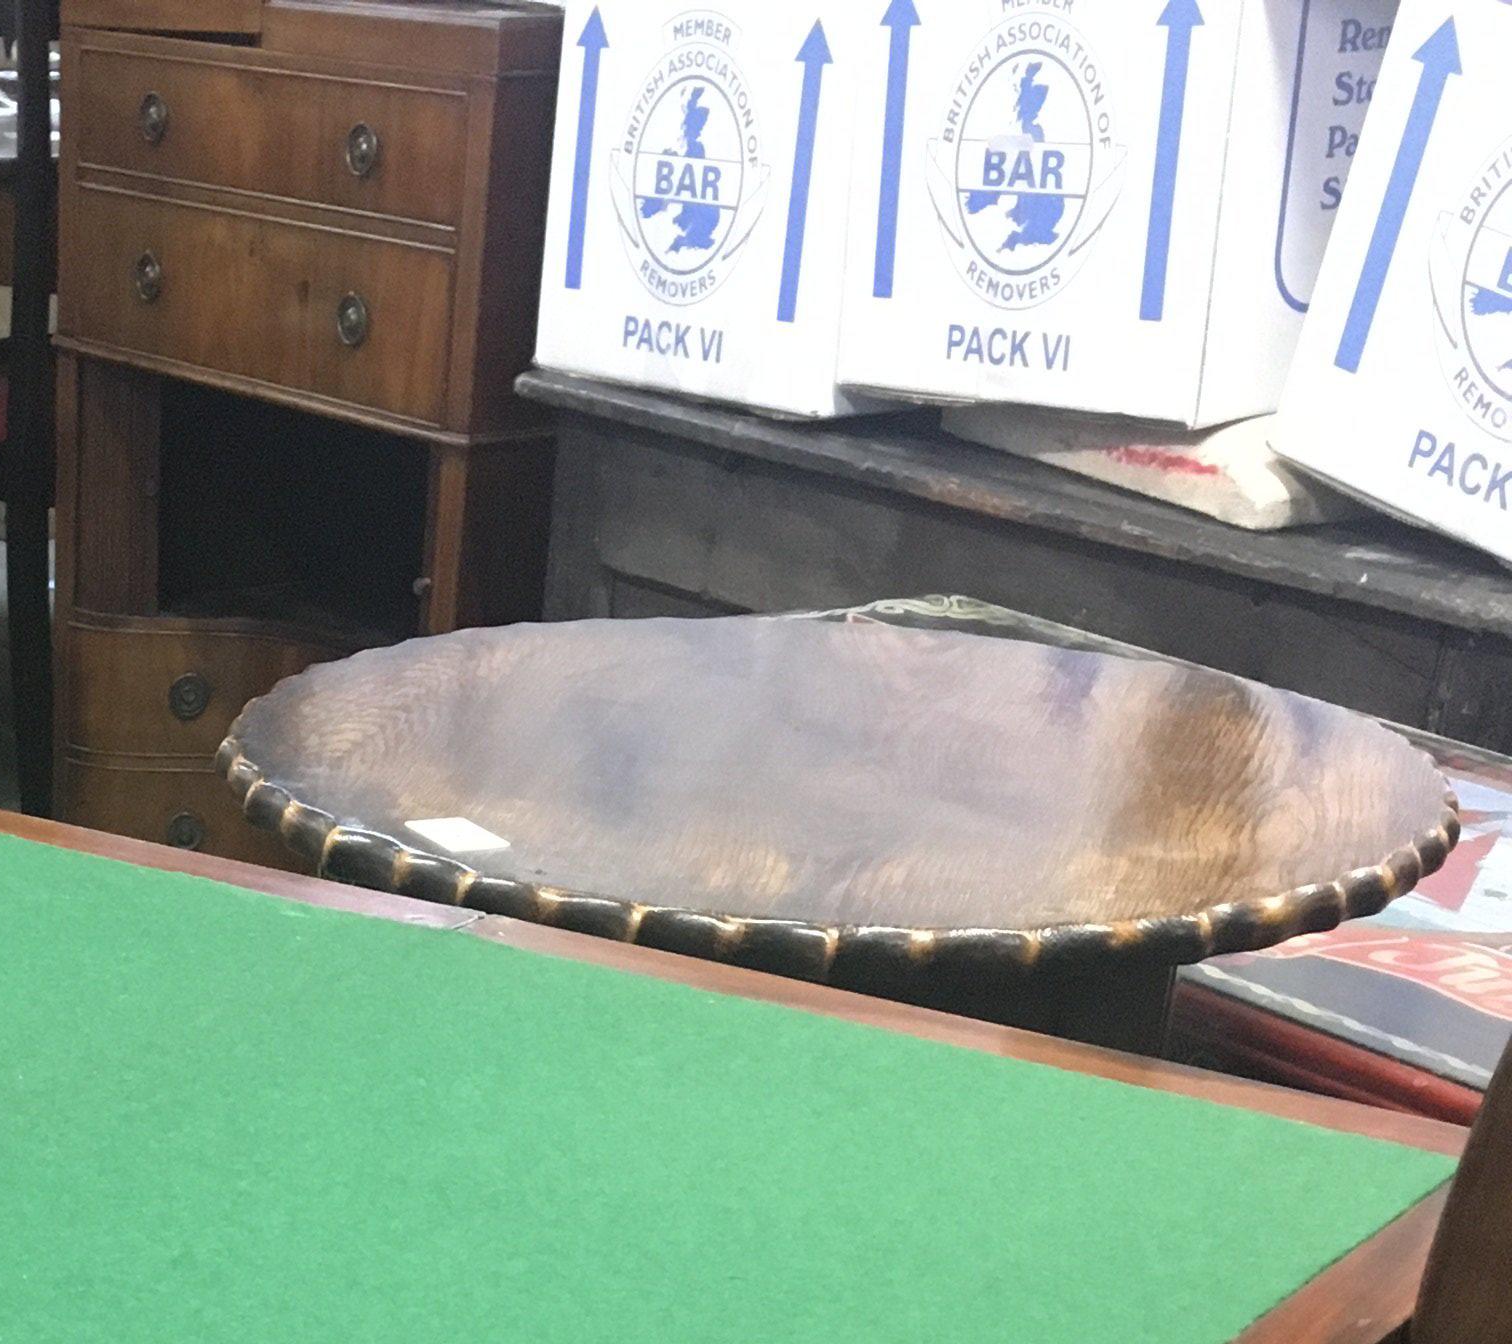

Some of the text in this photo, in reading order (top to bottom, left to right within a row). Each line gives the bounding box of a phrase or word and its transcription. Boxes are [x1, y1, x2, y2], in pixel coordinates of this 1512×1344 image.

[673, 19, 732, 46] MEMBER
[624, 50, 759, 168] BRITISH ASSOCIATION OF
[942, 21, 1112, 150] BRITISH ASSOCIATION OF
[654, 160, 722, 201] BAR
[982, 147, 1066, 190] BAR
[1459, 147, 1512, 226] BRITI
[639, 259, 716, 298] REMOVERS
[966, 260, 1061, 301] REMOVERS
[622, 315, 724, 364] PACK VI
[946, 324, 1071, 372] PACK VI
[1407, 429, 1512, 511] PACK
